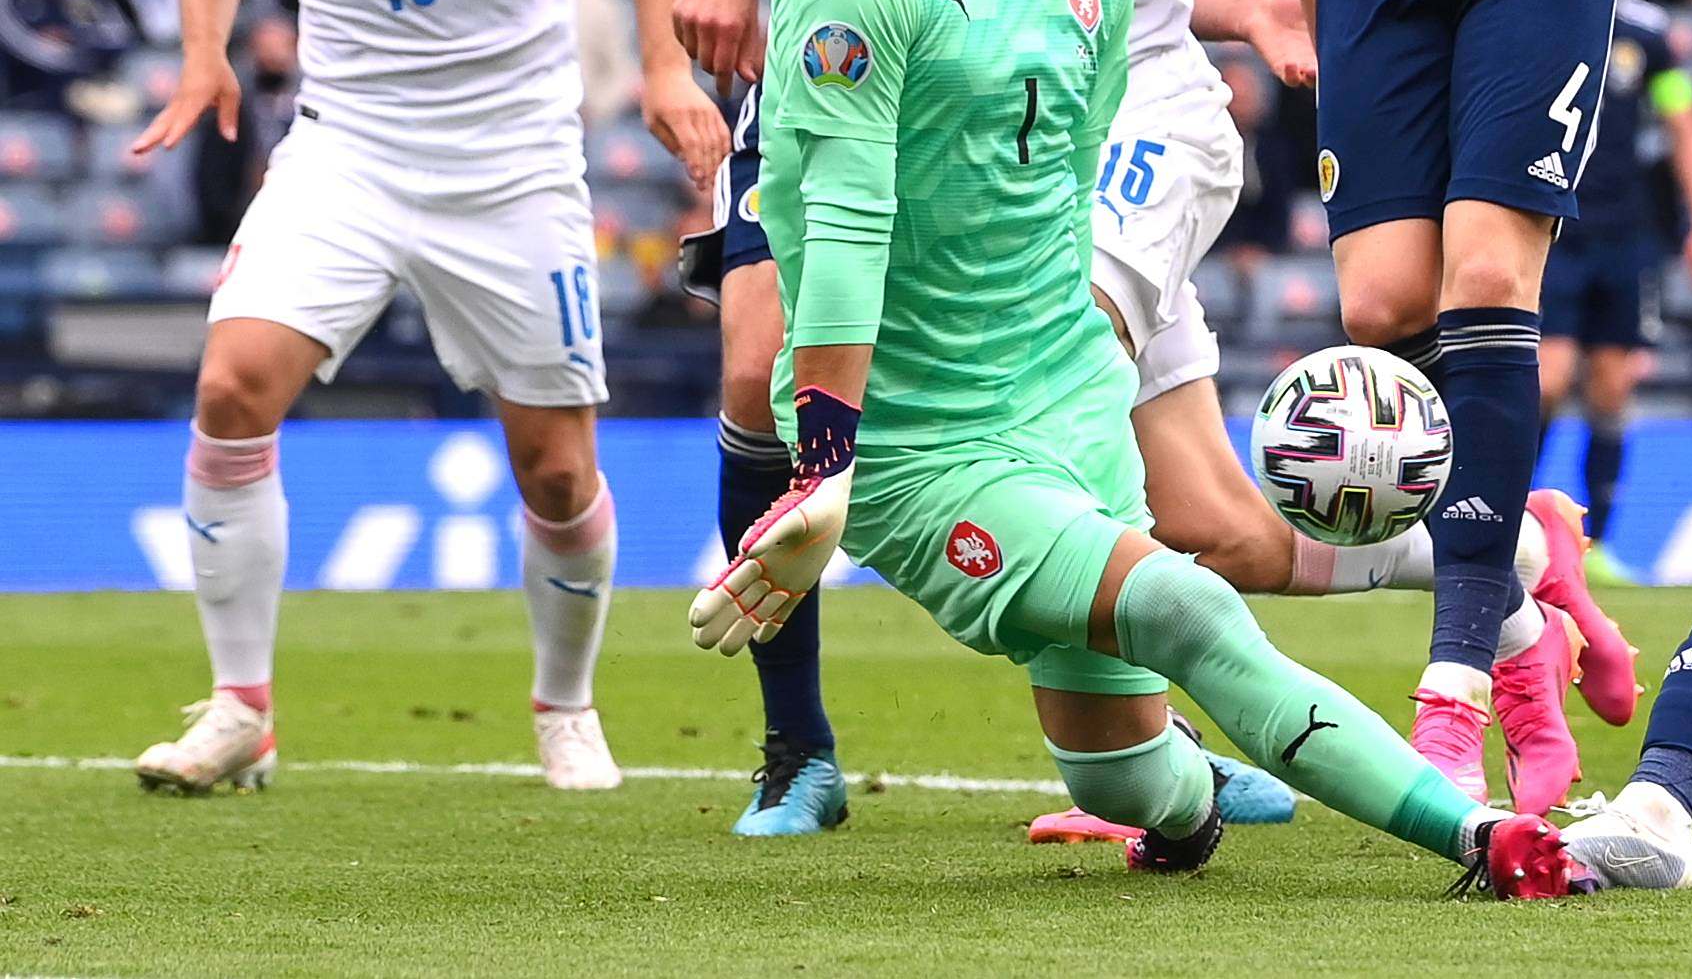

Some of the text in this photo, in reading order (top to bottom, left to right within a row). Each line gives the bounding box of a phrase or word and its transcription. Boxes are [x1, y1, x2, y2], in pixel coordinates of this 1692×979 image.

[1016, 77, 1038, 165] 1
[1548, 62, 1590, 153] 4
[1096, 139, 1166, 206] 15
[1527, 163, 1569, 189] adidas
[550, 265, 594, 347] 18
[1442, 508, 1503, 522] adidas
